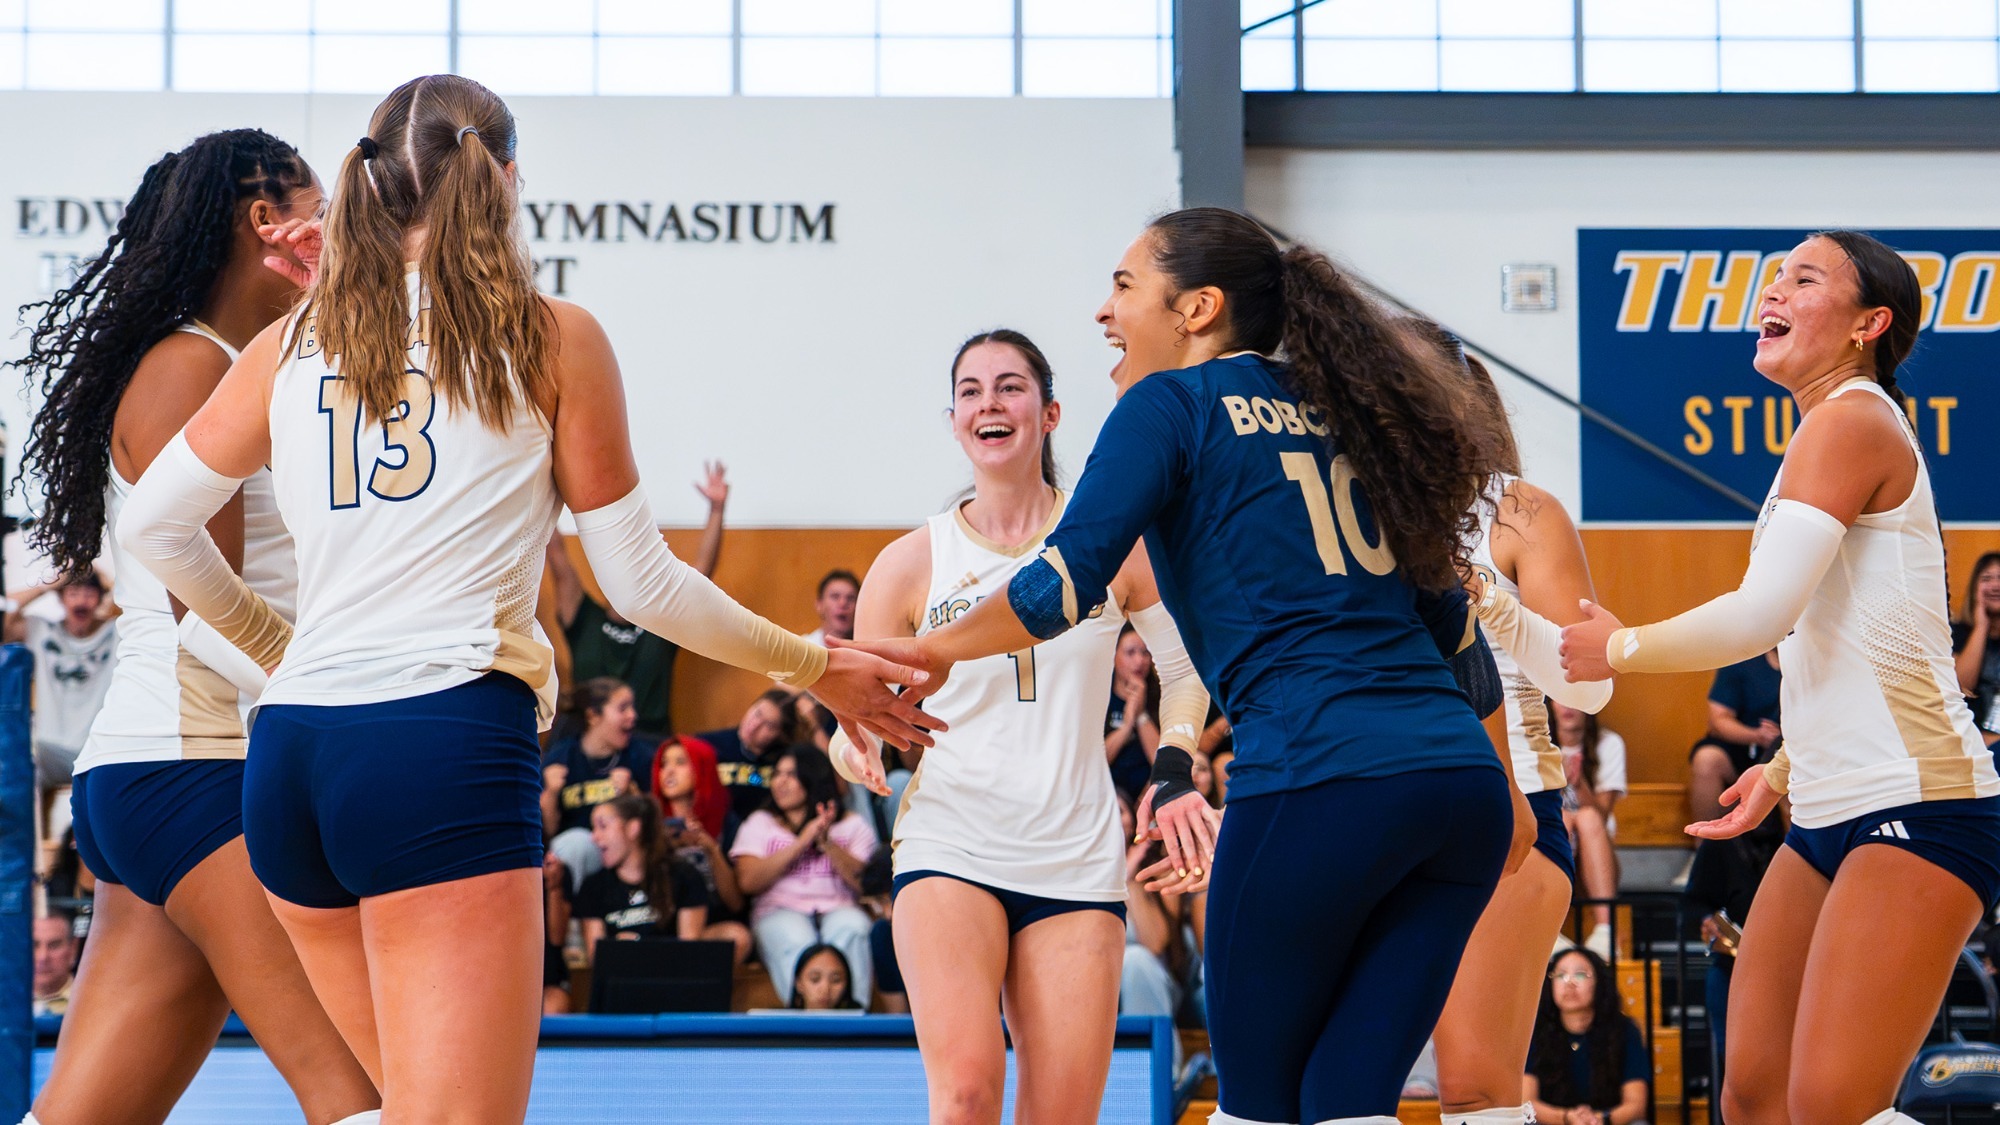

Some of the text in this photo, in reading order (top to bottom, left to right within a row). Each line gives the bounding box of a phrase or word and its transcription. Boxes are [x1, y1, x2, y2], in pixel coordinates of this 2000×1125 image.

[523, 202, 837, 243] YMNASIUM
[318, 368, 436, 511] 13
[1221, 395, 1332, 437] BOBC
[1279, 451, 1397, 576] 10
